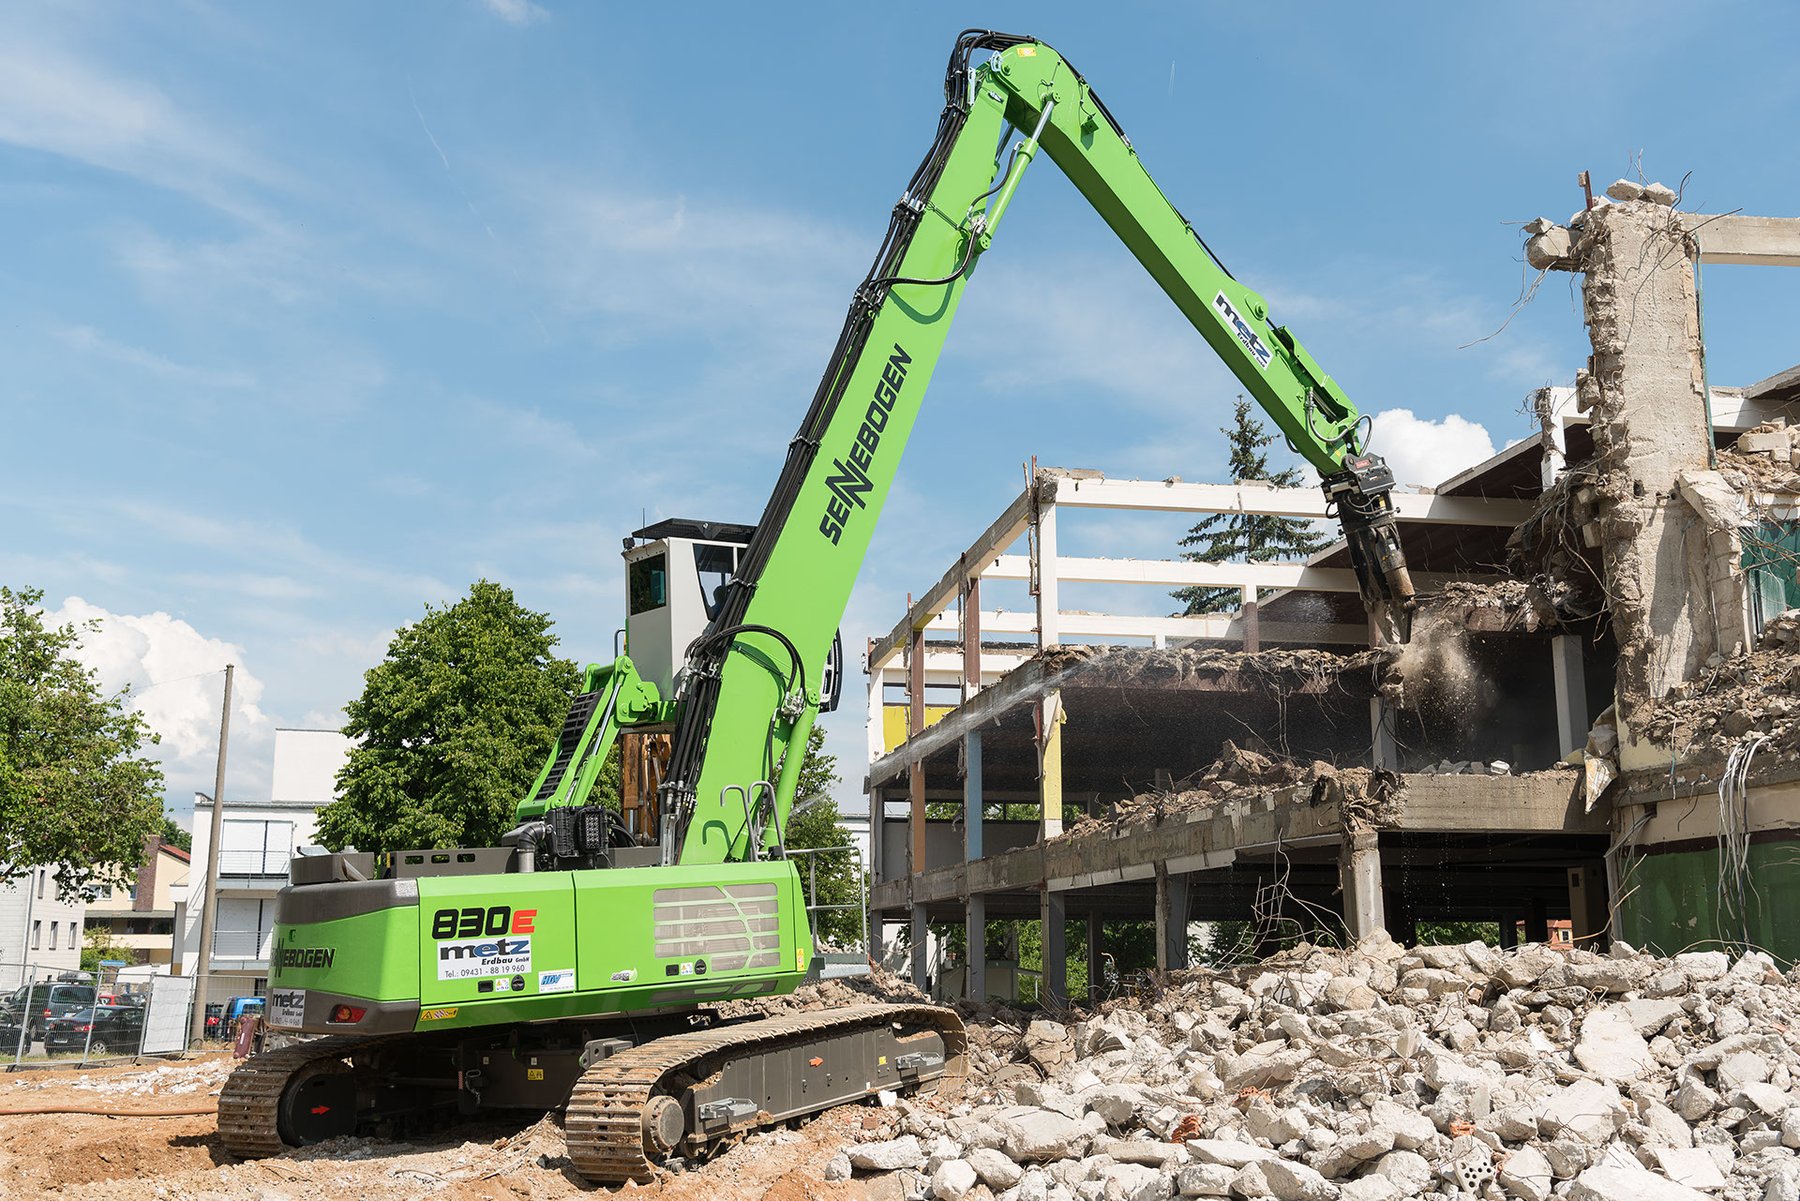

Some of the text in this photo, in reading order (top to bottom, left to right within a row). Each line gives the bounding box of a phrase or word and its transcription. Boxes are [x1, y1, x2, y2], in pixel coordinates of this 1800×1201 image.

[1216, 294, 1271, 364] metz
[819, 342, 912, 546] SENNEBOGEN
[432, 906, 537, 939] 830E
[440, 938, 530, 960] metz
[445, 970, 459, 978] Tel.:
[460, 968, 482, 977] 09431
[490, 966, 499, 974] 88
[501, 965, 510, 973] 19
[511, 964, 525, 972] 960
[481, 957, 513, 965] Erdbau
[272, 991, 304, 1009] metz
